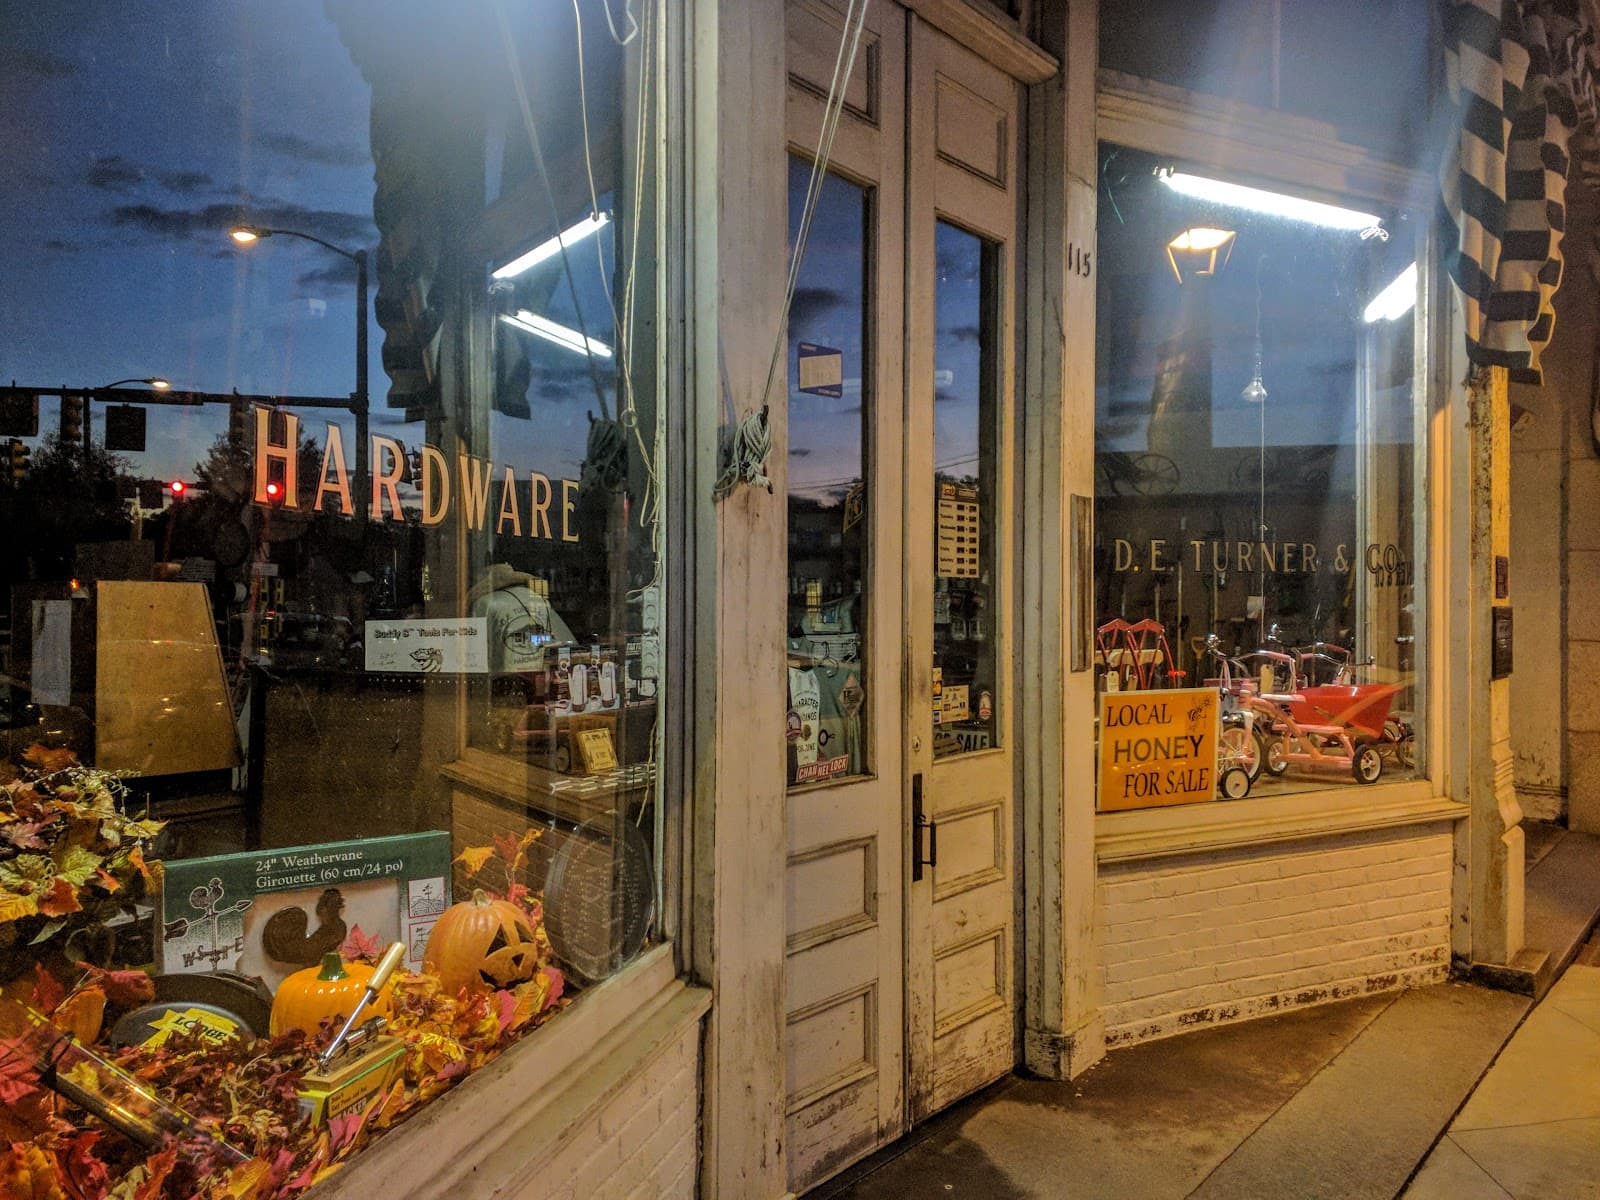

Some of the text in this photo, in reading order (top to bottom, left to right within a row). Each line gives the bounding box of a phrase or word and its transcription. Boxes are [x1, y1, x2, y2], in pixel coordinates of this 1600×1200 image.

[1068, 242, 1091, 278] 115
[252, 403, 580, 543] HARDWARE
[1190, 540, 1318, 573] TURNER
[1334, 543, 1350, 573] &
[1106, 704, 1173, 727] LOCAL
[1113, 735, 1205, 763] HONEY
[1123, 768, 1209, 798] FOR SALE
[255, 851, 363, 872] 24" Weathervane
[255, 859, 404, 888] Girouette (60 cm/24 po)
